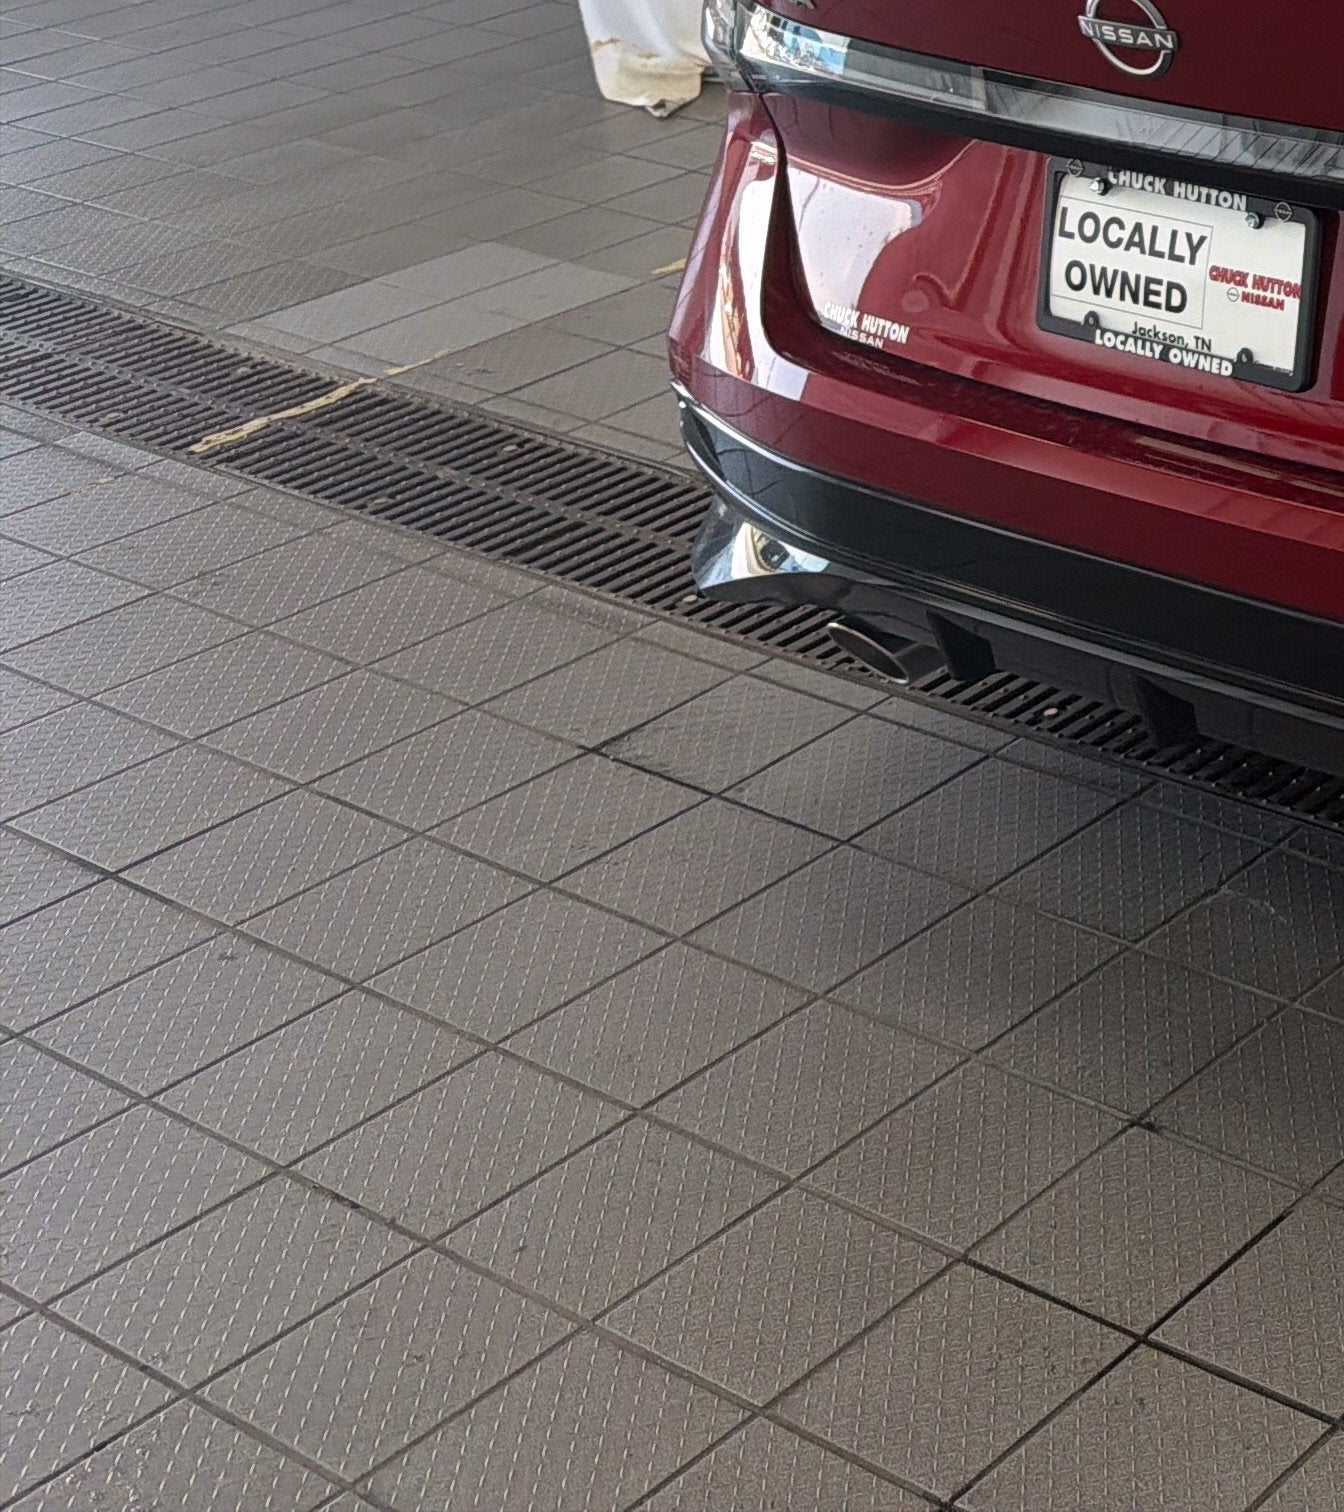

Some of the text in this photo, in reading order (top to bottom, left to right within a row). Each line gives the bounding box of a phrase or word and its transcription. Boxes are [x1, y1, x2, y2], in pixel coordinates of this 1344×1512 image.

[1080, 20, 1174, 49] NISSAN
[1107, 168, 1247, 212] CHUCK HUTTON
[1058, 206, 1208, 266] LOCALLY
[1064, 259, 1188, 314] OWNED
[1208, 264, 1302, 300] CHUCK HUTTON
[1240, 290, 1285, 311] NISSAN
[824, 301, 911, 344] CHUCK HUTTON
[839, 326, 885, 349] NISSAN
[1131, 321, 1212, 352] Jackson, TN
[1094, 328, 1234, 377] LOCALLY OWNED
